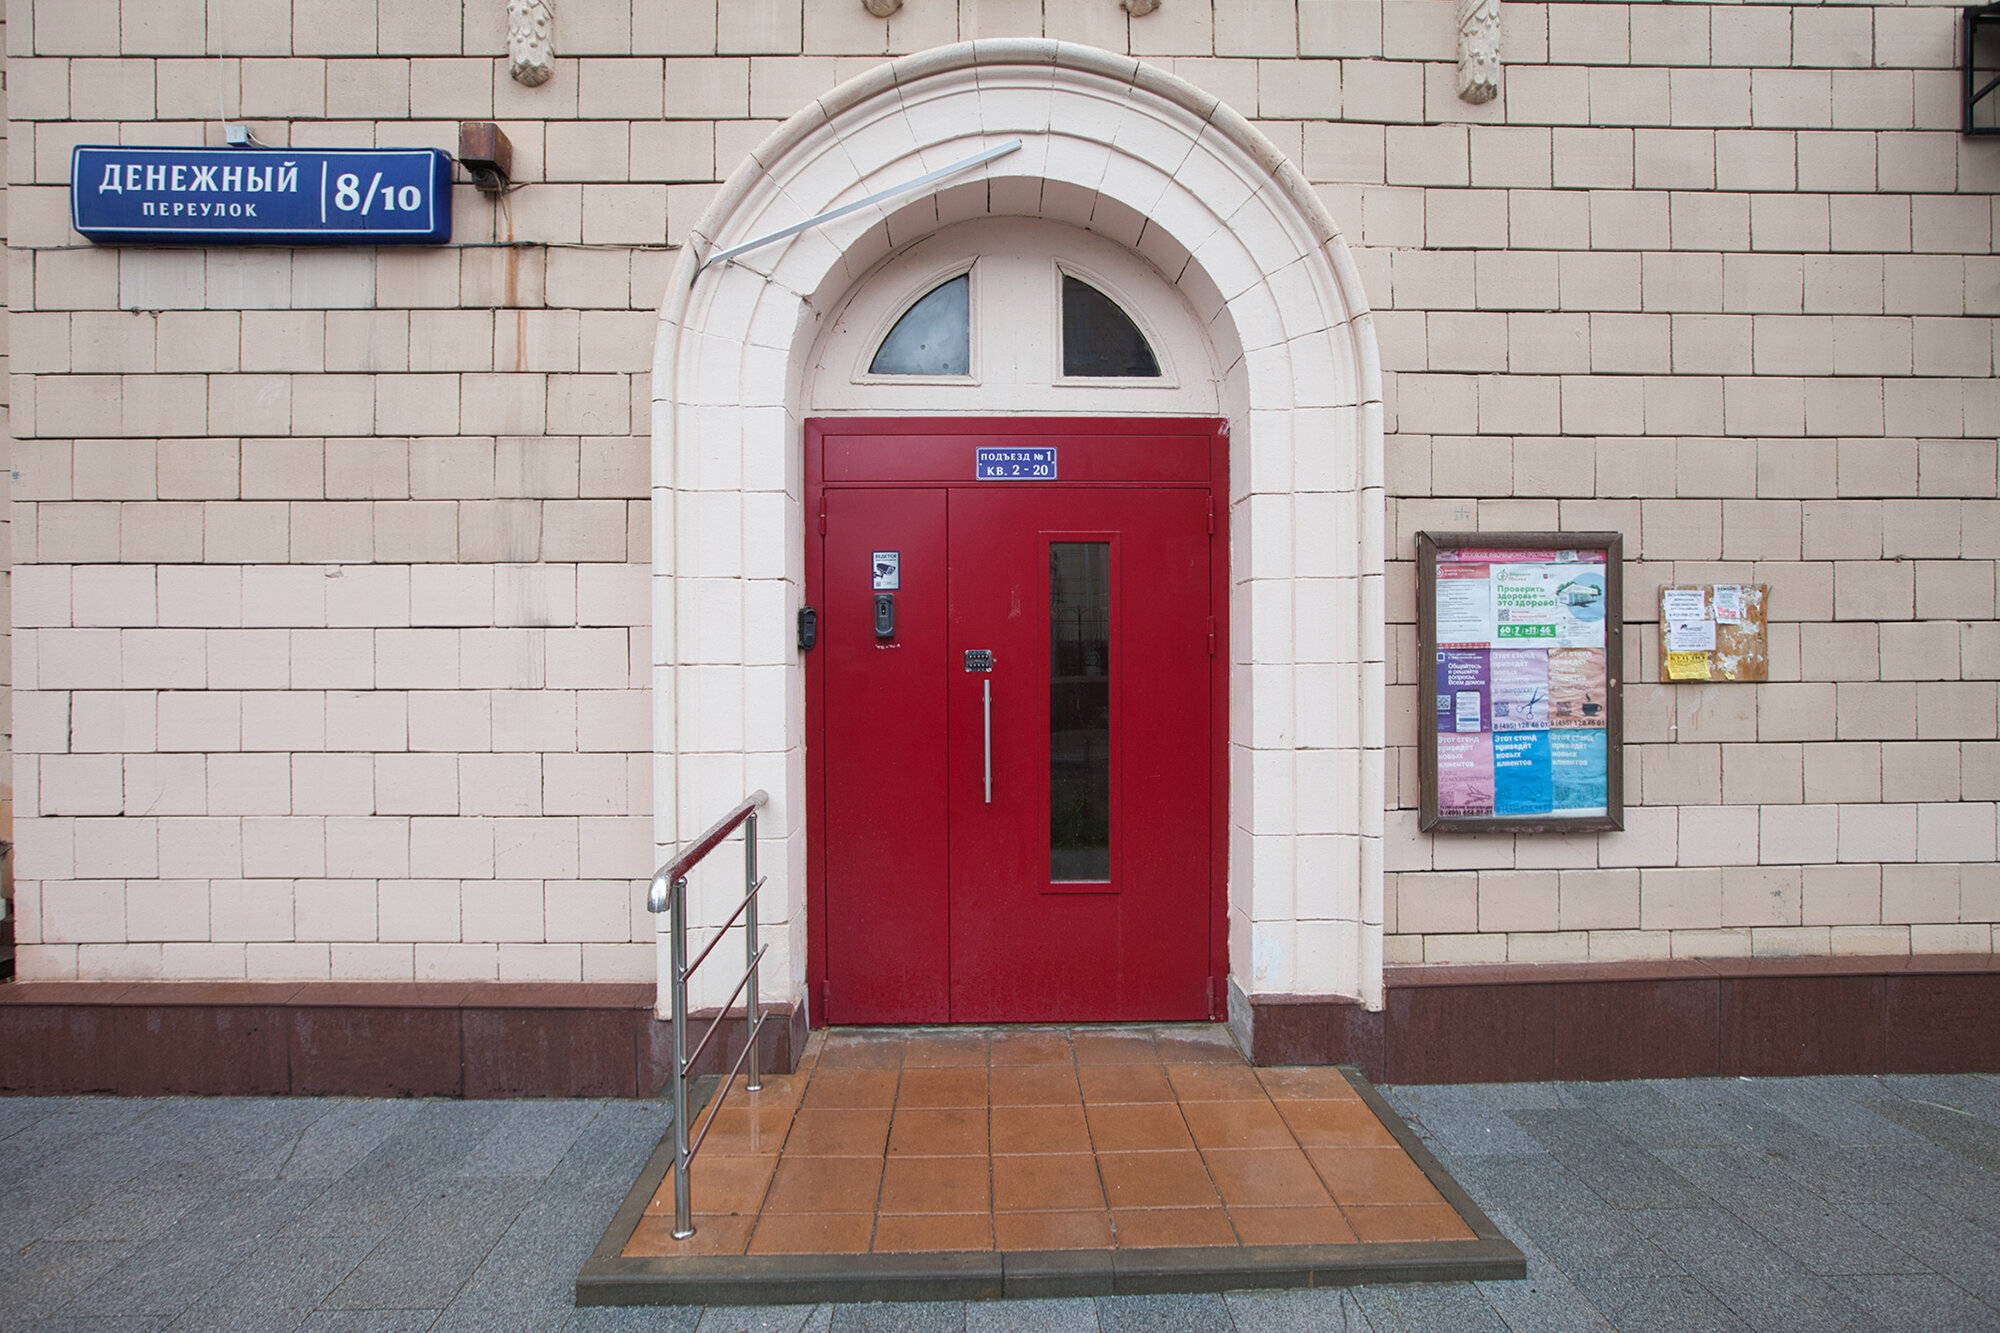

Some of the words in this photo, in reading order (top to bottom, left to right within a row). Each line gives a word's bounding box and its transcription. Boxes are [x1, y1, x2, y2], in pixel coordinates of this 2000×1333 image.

[99, 161, 298, 195] ДЕНЕЖНЫЙ
[334, 172, 422, 215] 8/10
[142, 202, 258, 217] ПЕРЕУЛОК
[981, 453, 1030, 461] ПОДЪЕЗД
[1034, 453, 1044, 461] №
[1046, 451, 1051, 461] 1
[987, 466, 1008, 476] КВ.
[1012, 464, 1020, 475] 2
[1033, 464, 1049, 475] 20
[1497, 585, 1545, 594] Проверить
[1513, 734, 1537, 742] стенд
